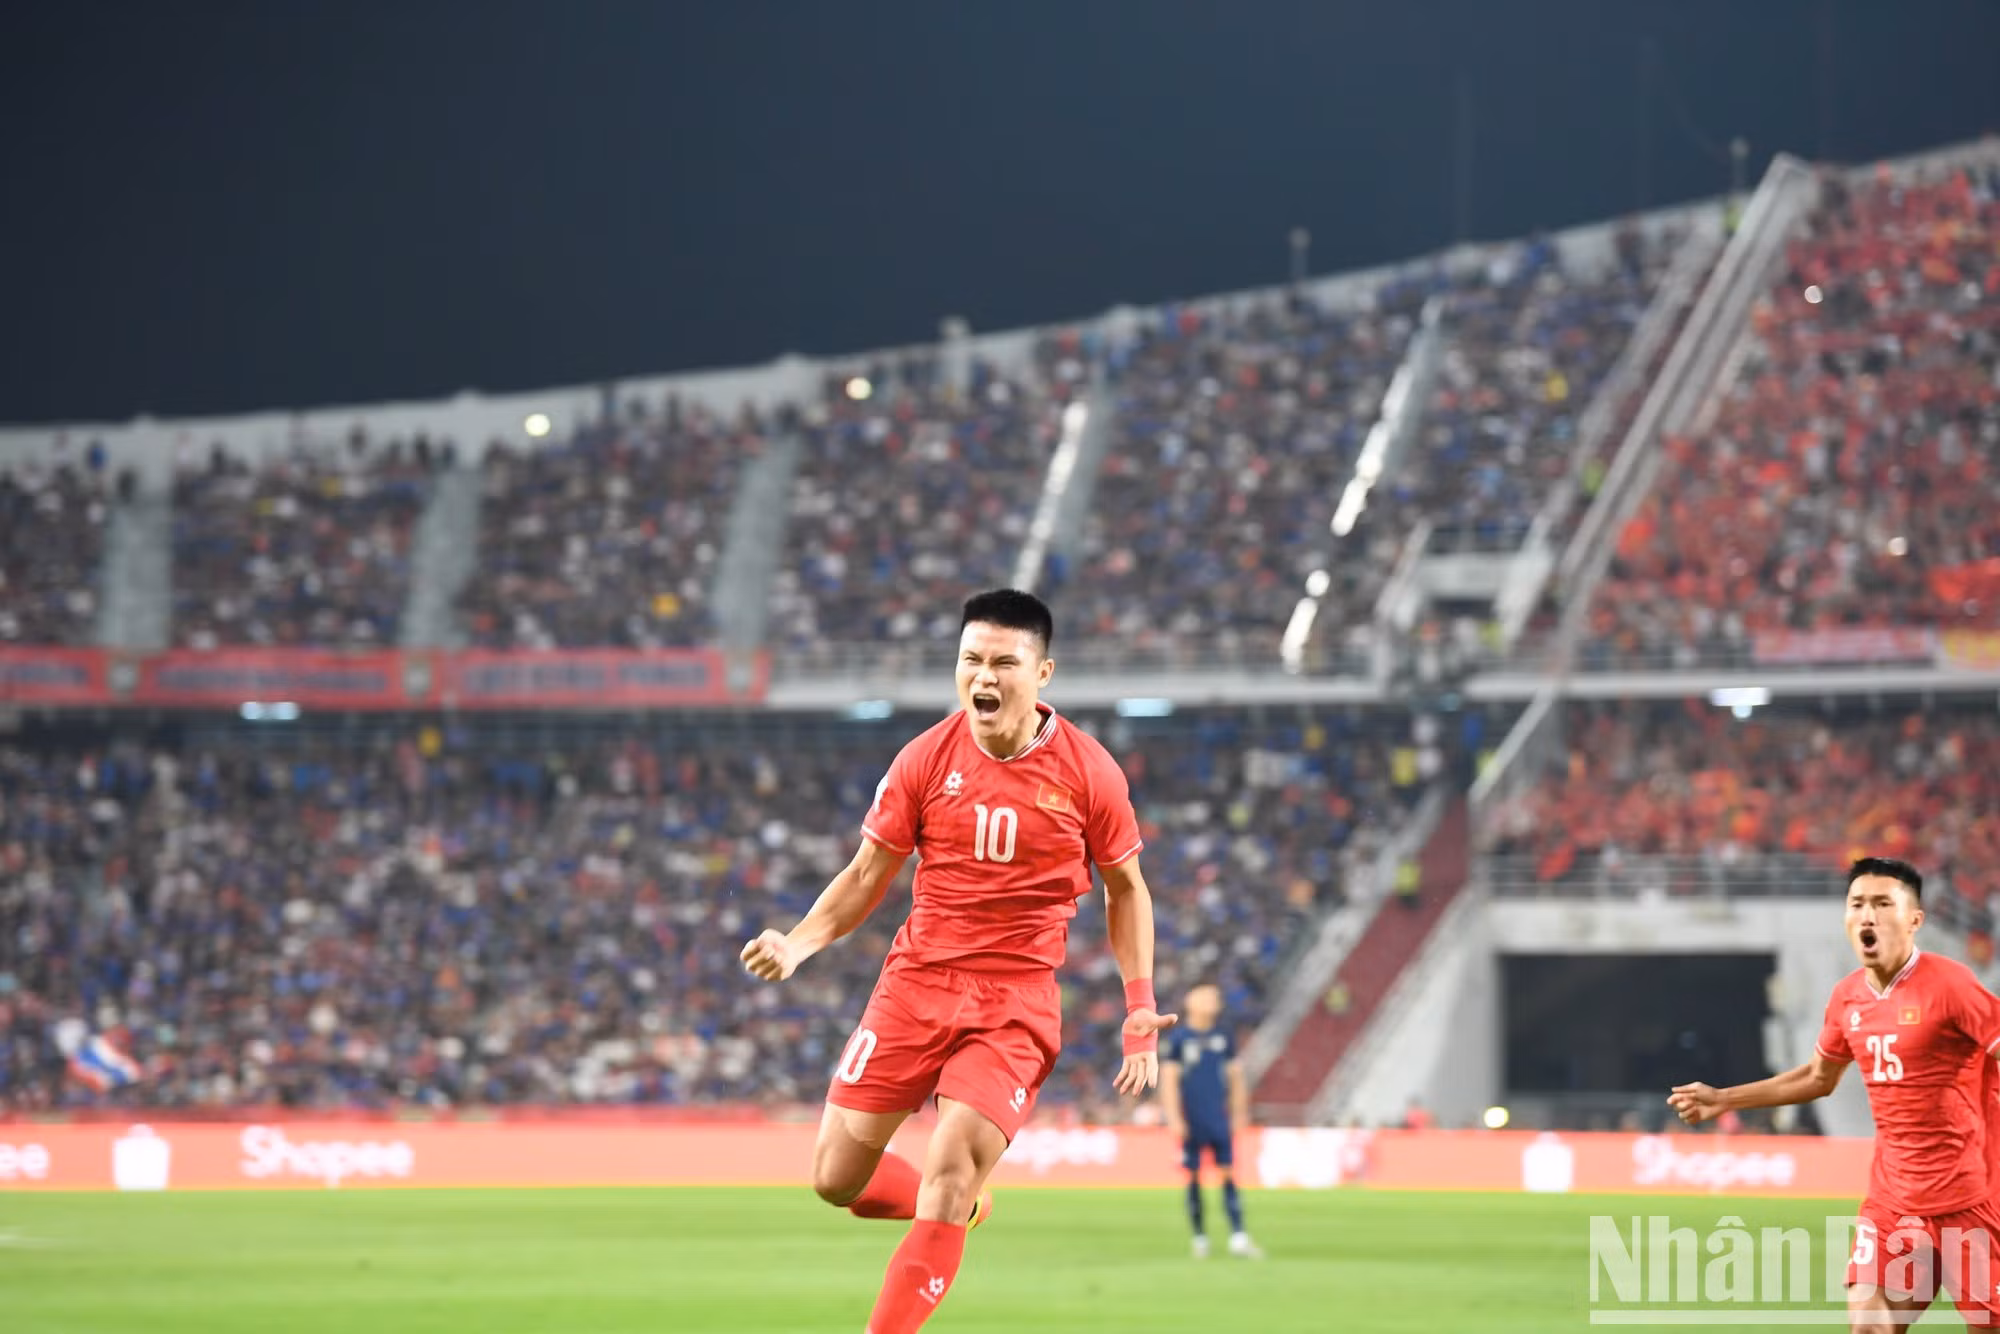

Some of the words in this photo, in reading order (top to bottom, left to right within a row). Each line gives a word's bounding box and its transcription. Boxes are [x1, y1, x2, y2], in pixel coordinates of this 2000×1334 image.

[974, 804, 1018, 863] 10
[835, 1025, 878, 1084] 0
[1866, 1034, 1904, 1082] 25
[240, 1126, 414, 1188] Shopee
[1003, 1128, 1118, 1175] opee
[1633, 1136, 1796, 1194] Shopee
[1848, 1224, 1878, 1265] 5
